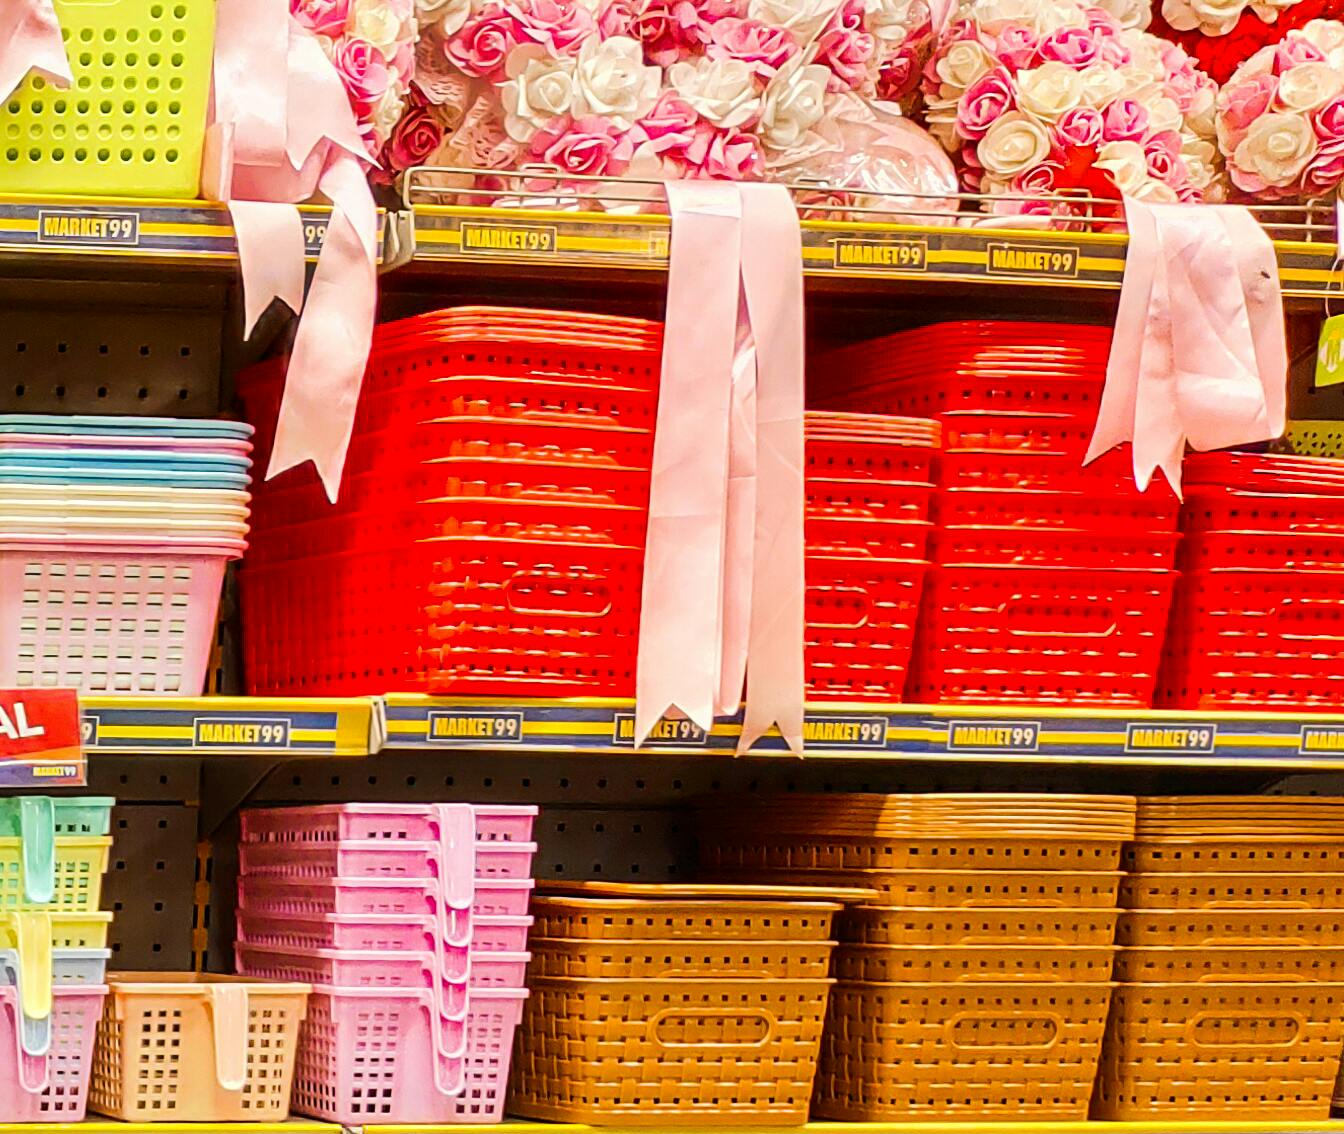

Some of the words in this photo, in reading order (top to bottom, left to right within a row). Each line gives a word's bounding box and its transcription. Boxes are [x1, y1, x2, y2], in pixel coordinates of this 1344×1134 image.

[43, 217, 132, 239] MARKET99
[465, 227, 551, 251] MARKET99
[840, 242, 921, 265] MARKET99
[992, 249, 1073, 271] MARKET99
[200, 722, 284, 743] MARKET99
[433, 716, 517, 737] MARKET99
[620, 719, 700, 739] MKET99
[803, 721, 881, 741] MARKET99
[953, 724, 1033, 746] MARKET99
[1131, 727, 1209, 748] MARKET99
